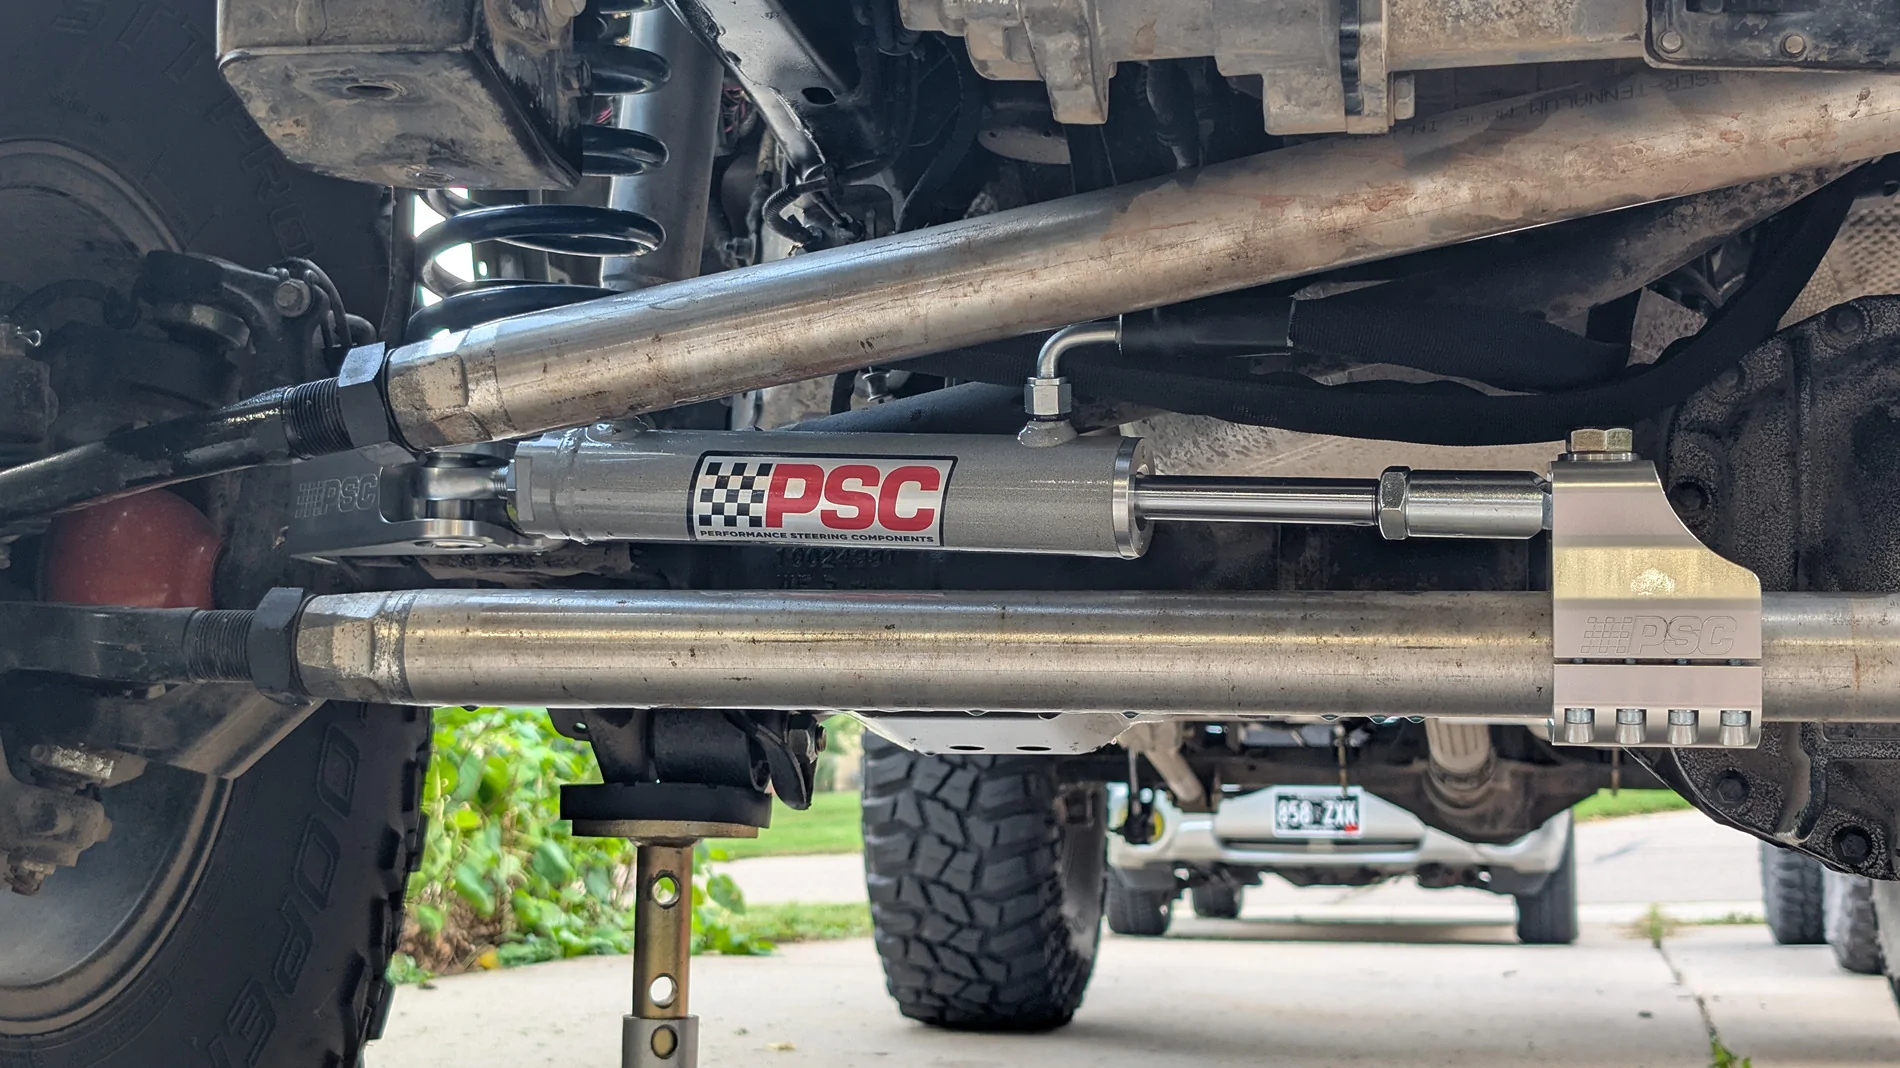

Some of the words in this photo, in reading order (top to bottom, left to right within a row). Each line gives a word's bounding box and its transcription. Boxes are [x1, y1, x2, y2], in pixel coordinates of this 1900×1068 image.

[320, 473, 378, 515] PSC
[765, 463, 941, 532] PSC
[700, 529, 788, 540] PERFORMANCE
[790, 532, 848, 541] STEERING
[851, 533, 934, 543] COMPONENTS
[1627, 615, 1738, 656] PSC
